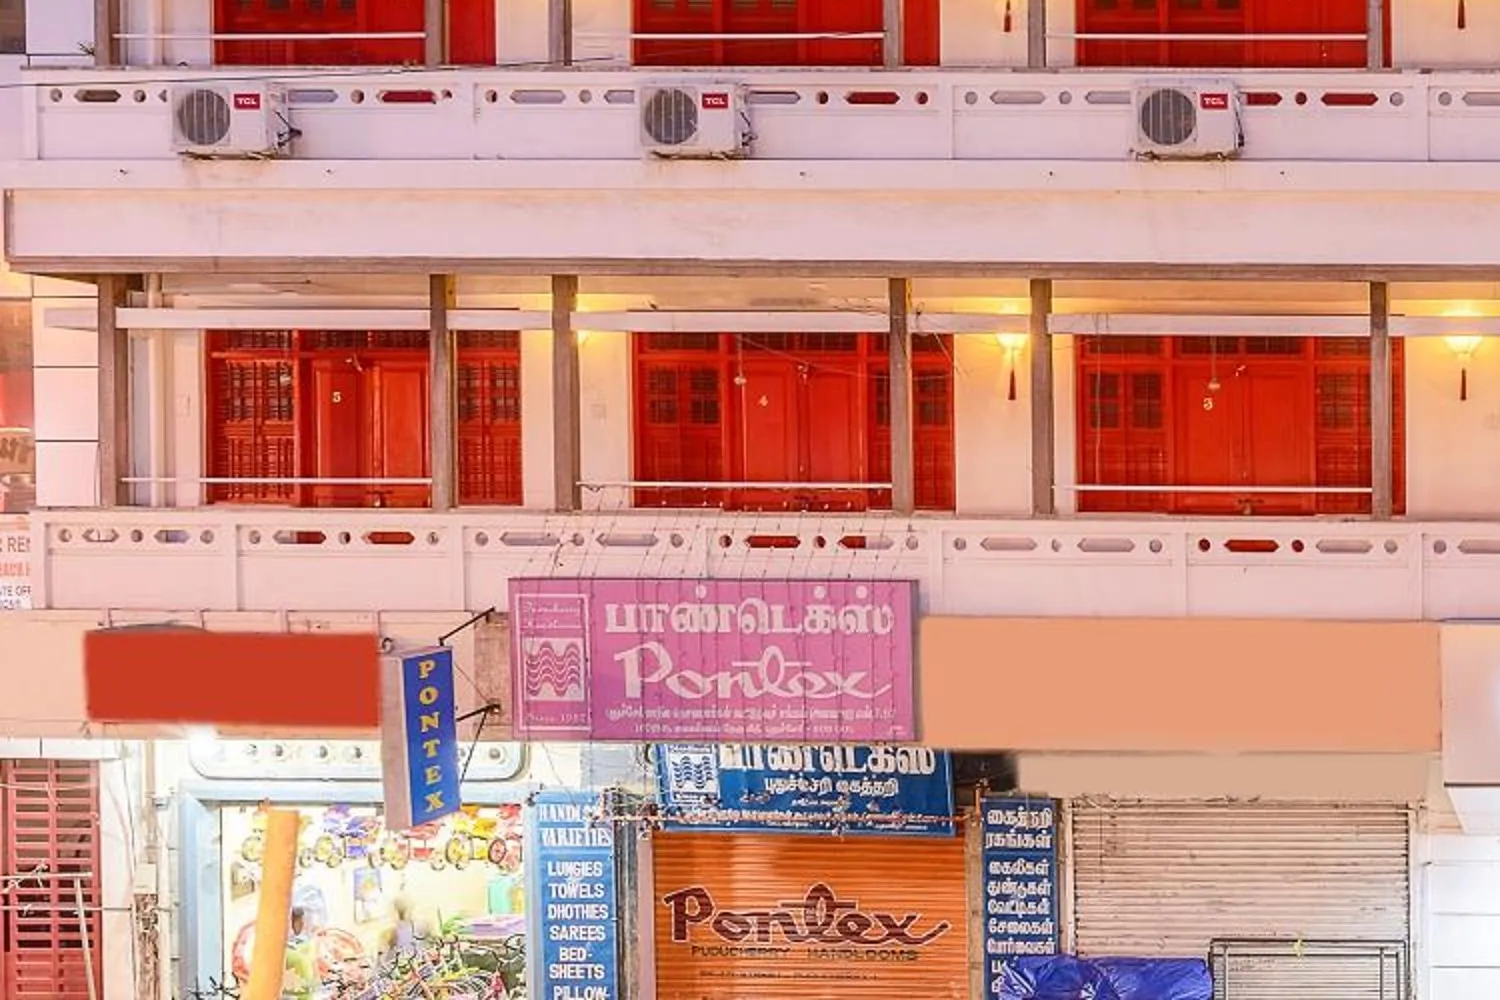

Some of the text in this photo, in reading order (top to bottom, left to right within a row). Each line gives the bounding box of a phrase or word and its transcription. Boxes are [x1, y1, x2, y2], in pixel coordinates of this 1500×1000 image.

[237, 97, 259, 105] TCL
[705, 97, 725, 105] TCL
[1202, 97, 1225, 105] TCL
[604, 584, 894, 635] பாண்டெக்ஸ்
[613, 640, 892, 699] Pontex
[419, 660, 445, 813] PONTEX
[541, 827, 612, 847] VARIETIES
[547, 861, 603, 877] LUNGIES
[548, 883, 605, 899] TOWELS
[548, 903, 609, 919] DHOTHIES
[662, 882, 953, 946] Pontex
[549, 925, 606, 942] SAREES
[559, 947, 592, 961] BED-
[549, 964, 605, 979] SHEETS
